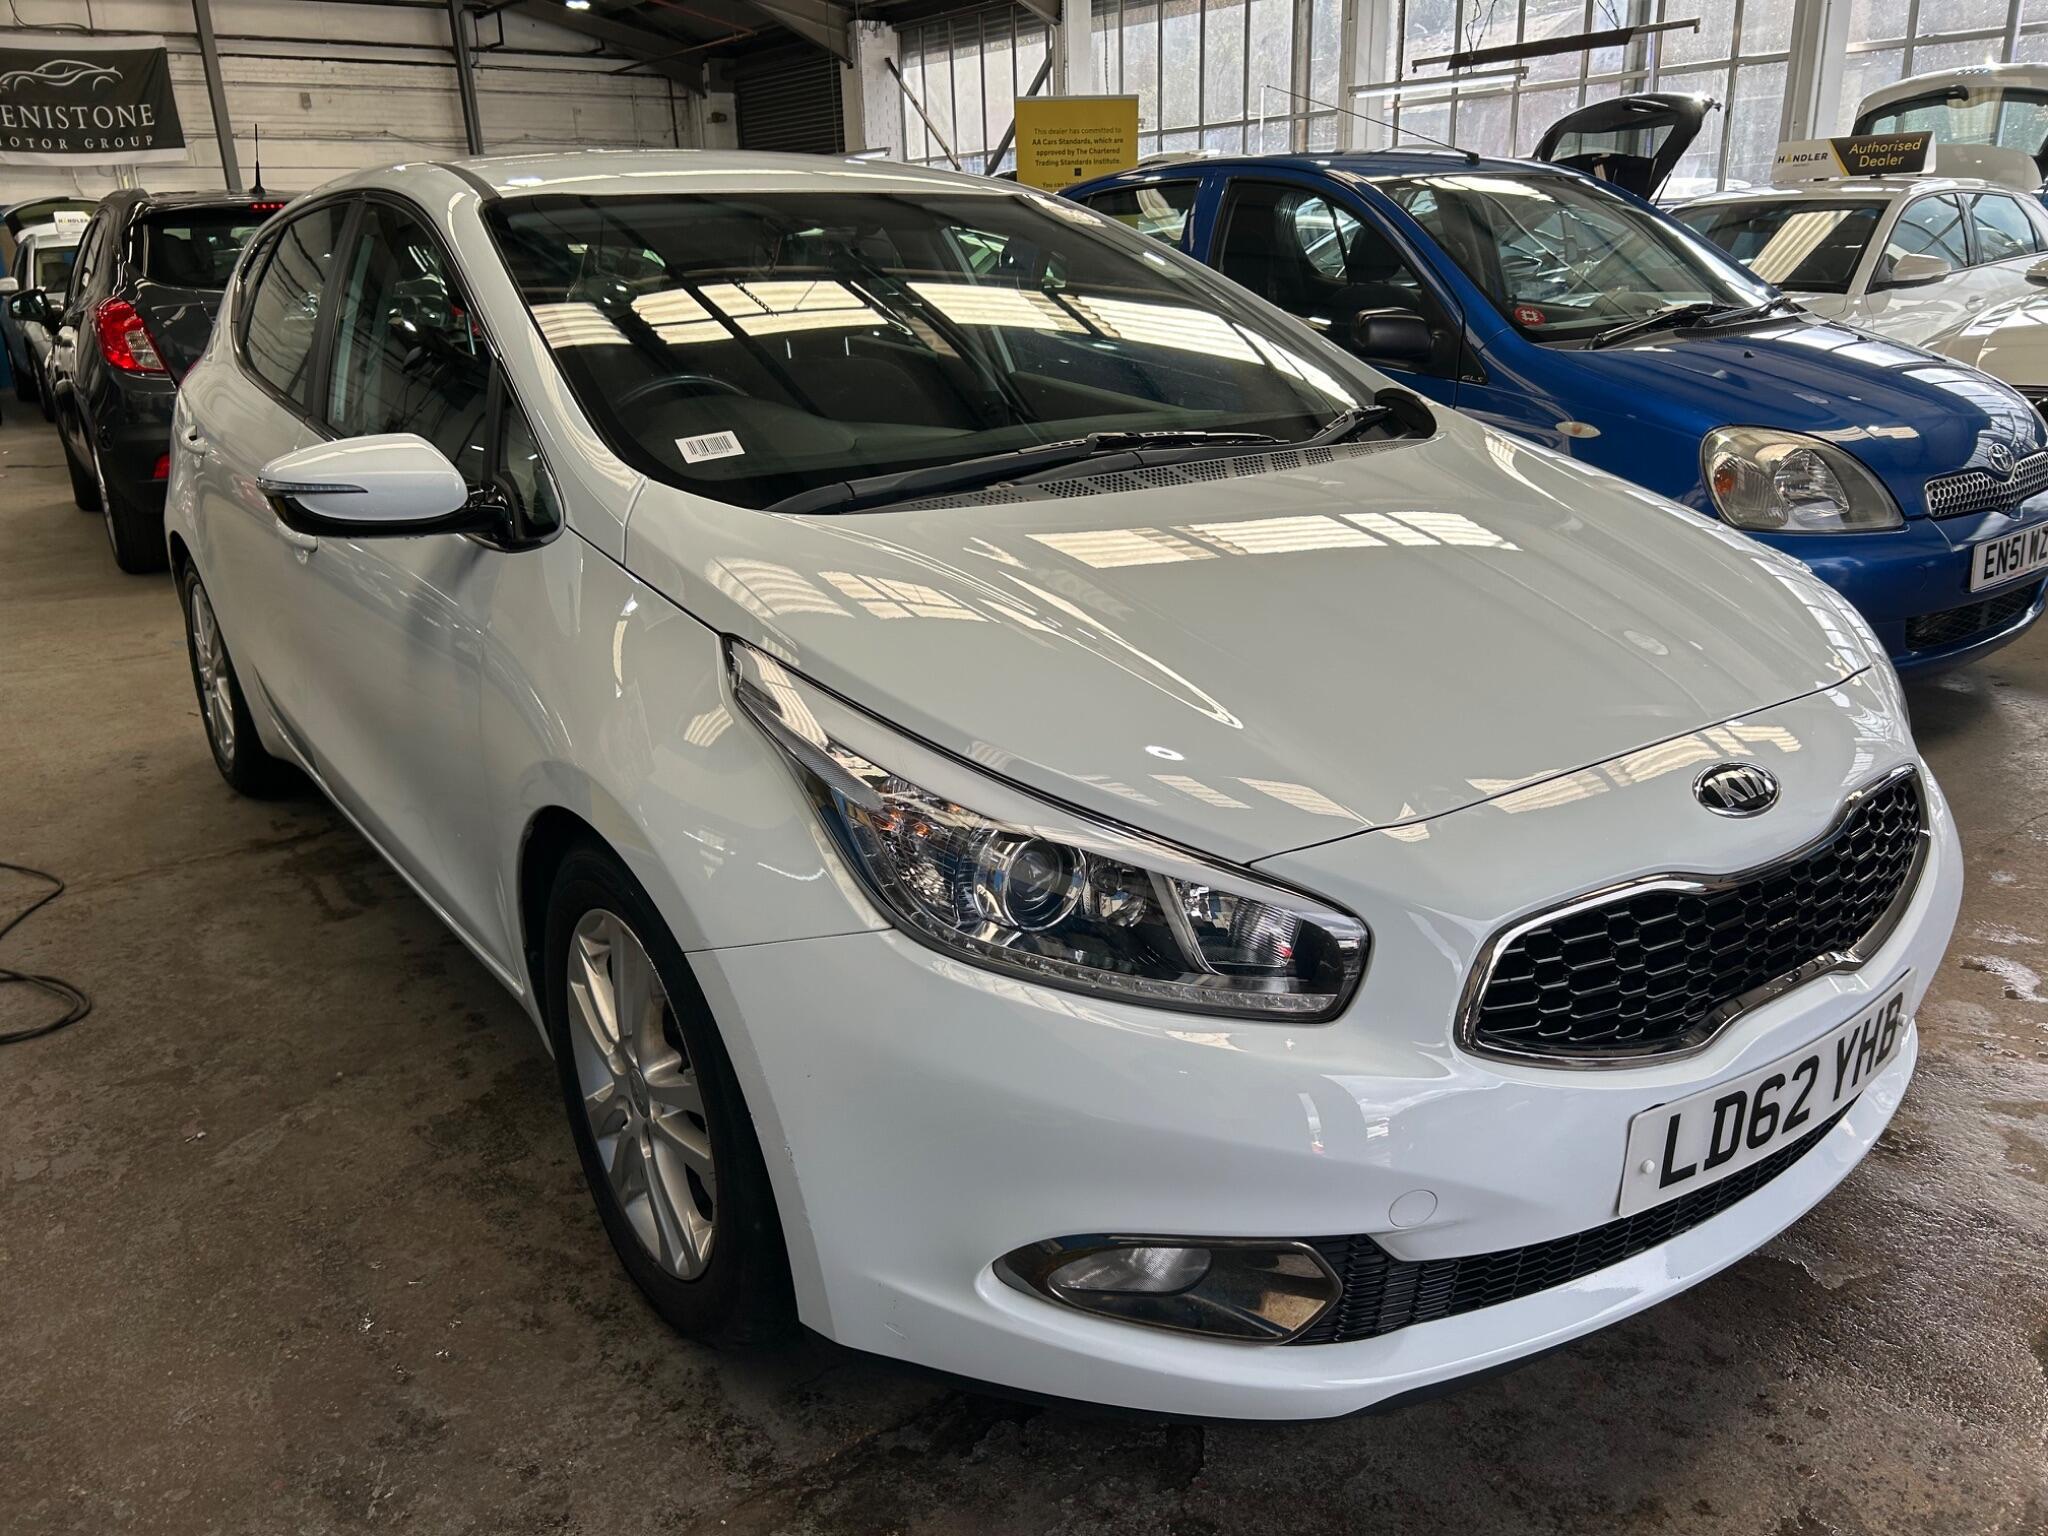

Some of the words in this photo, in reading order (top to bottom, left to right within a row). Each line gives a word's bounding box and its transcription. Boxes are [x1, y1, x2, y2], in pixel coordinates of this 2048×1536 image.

[1034, 127, 1047, 135] This
[0, 135, 68, 150] OTOR
[84, 135, 153, 150] GROUP
[1042, 138, 1058, 146] Cars
[1094, 137, 1114, 145] which
[1848, 137, 1923, 155] Authorised
[1036, 148, 1066, 157] approved
[1067, 148, 1075, 157] by
[1076, 147, 1088, 155] The
[1088, 147, 1120, 155] Chartered
[1777, 152, 1828, 164] HANDLER
[1035, 159, 1059, 167] Trading
[1060, 158, 1093, 166] Standards
[1859, 154, 1905, 168] Dealer
[1983, 533, 2027, 580] EN51
[1703, 766, 1775, 808] KIA
[1658, 1054, 1820, 1189] LD62
[1832, 991, 1904, 1102] YHB
